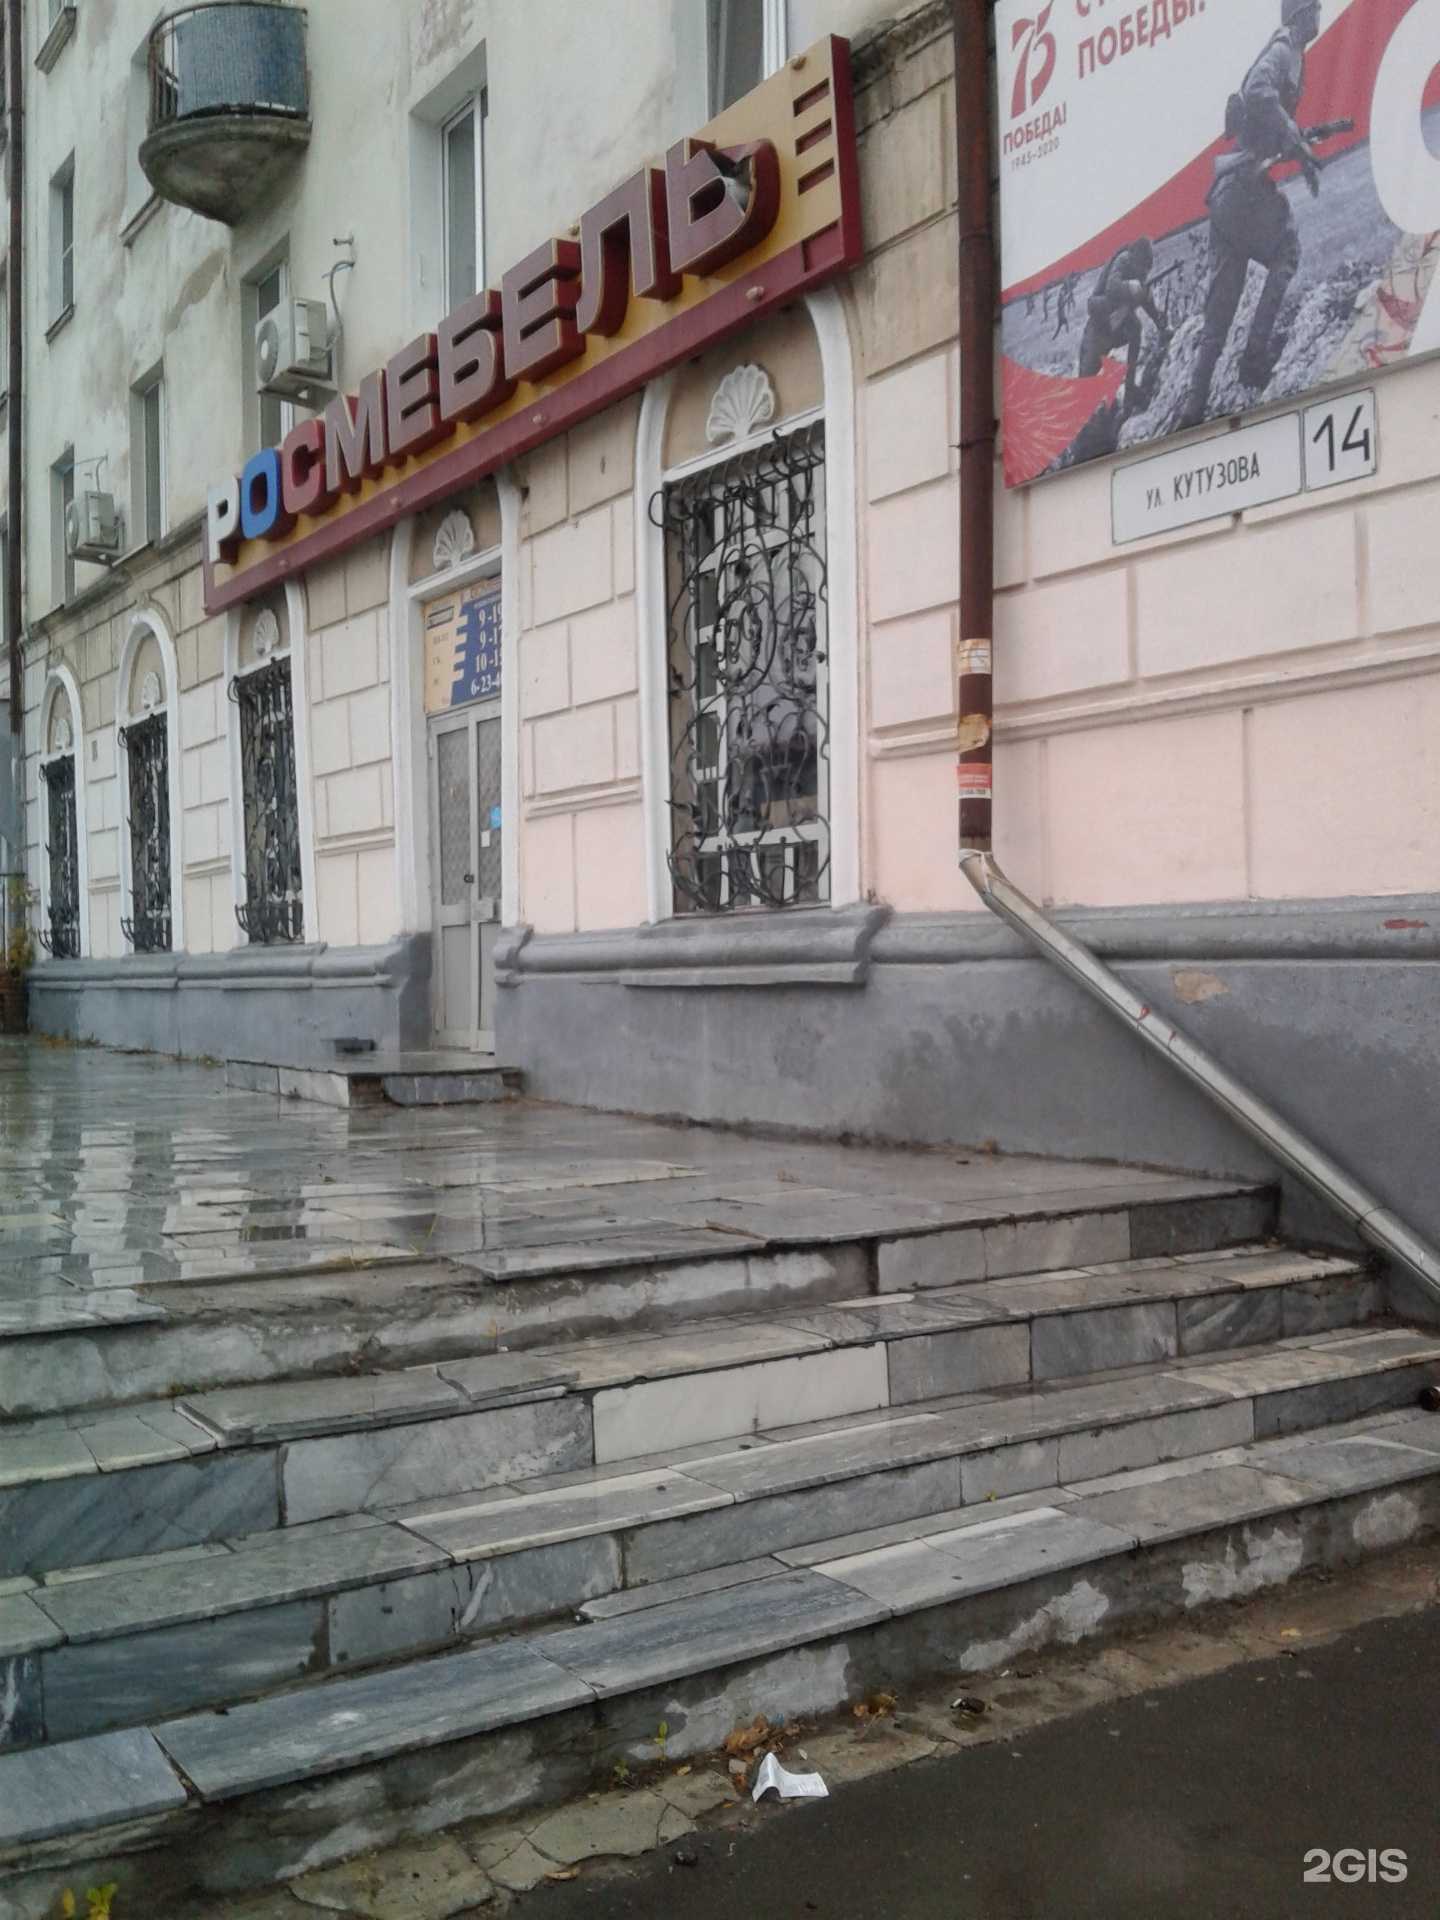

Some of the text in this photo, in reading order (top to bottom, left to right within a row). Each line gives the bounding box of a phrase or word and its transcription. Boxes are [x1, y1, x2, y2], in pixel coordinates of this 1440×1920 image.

[1002, 101, 1067, 156] ПОБЕДА!
[206, 135, 783, 566] РОСМЕБЕЛЬ
[1173, 451, 1260, 503] КУТУЗОВА
[1312, 404, 1371, 472] 14
